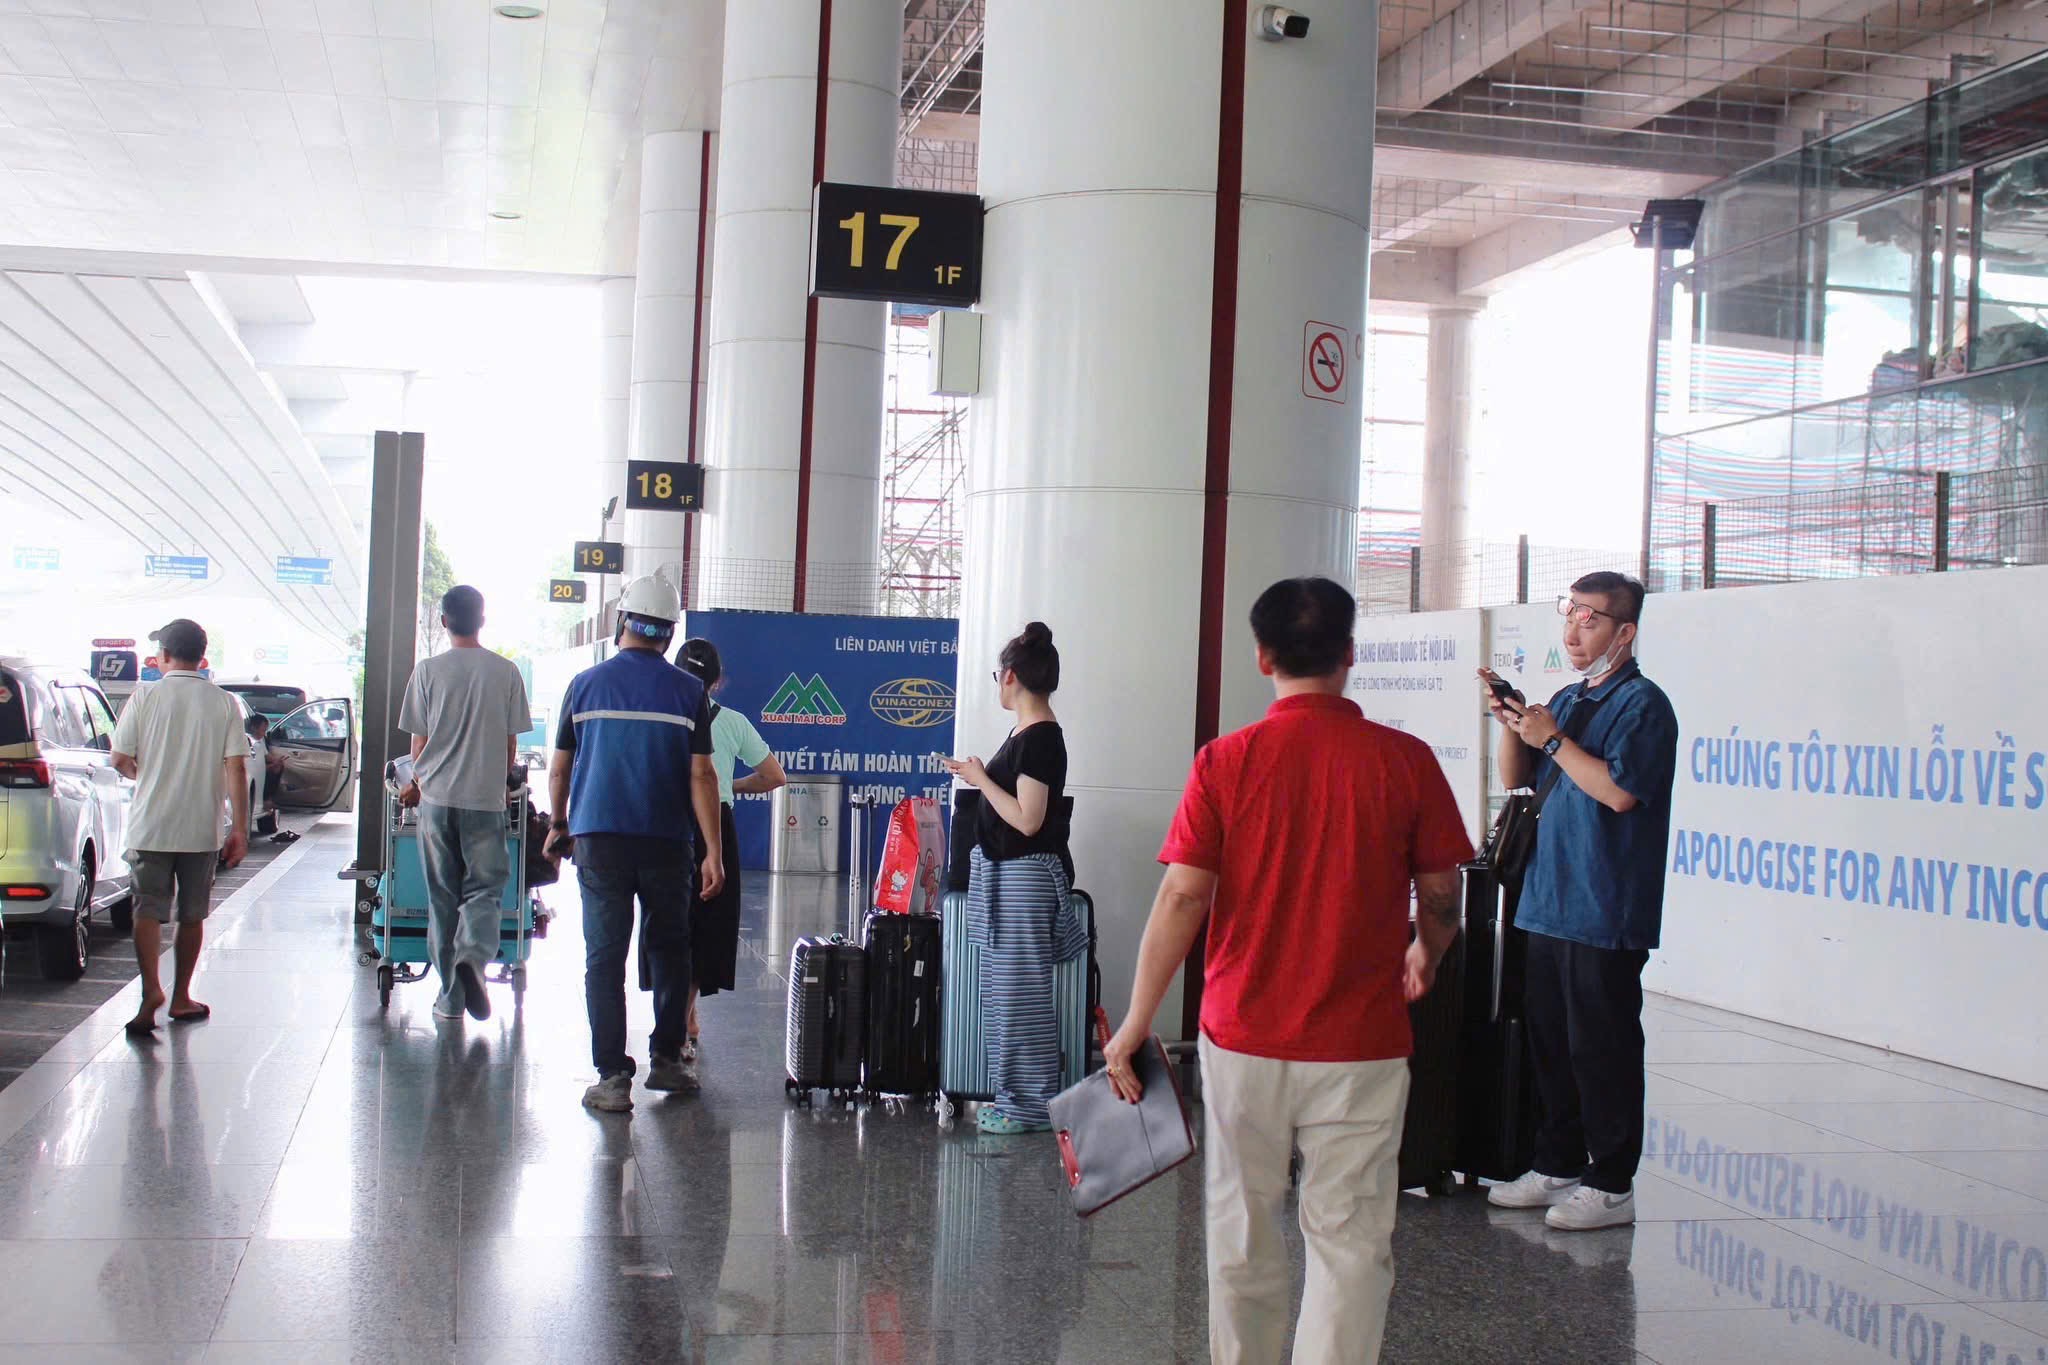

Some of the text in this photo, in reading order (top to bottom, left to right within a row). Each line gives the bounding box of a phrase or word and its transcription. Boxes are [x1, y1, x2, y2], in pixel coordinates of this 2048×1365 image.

[839, 211, 920, 270] 17
[934, 264, 962, 285] 1F
[636, 471, 673, 499] 18
[680, 495, 694, 505] 1F
[579, 549, 604, 566] 19
[553, 585, 573, 598] 20
[835, 636, 864, 652] LIÊN
[868, 639, 905, 653] DANH
[909, 638, 937, 656] VIỆT
[1494, 653, 1512, 667] TEXO
[876, 697, 953, 708] VINACONEX
[761, 713, 847, 725] XUAN MAI CORP
[774, 746, 817, 770] UYẾT
[822, 749, 859, 772] TÂM
[864, 750, 912, 774] HOÀN
[1691, 724, 2047, 811] CHÚNG TÔI XIN LỖI VỀ S
[922, 782, 952, 805] TIẾ
[1673, 829, 2048, 932] APOLOGISE FOR ANY INCO
